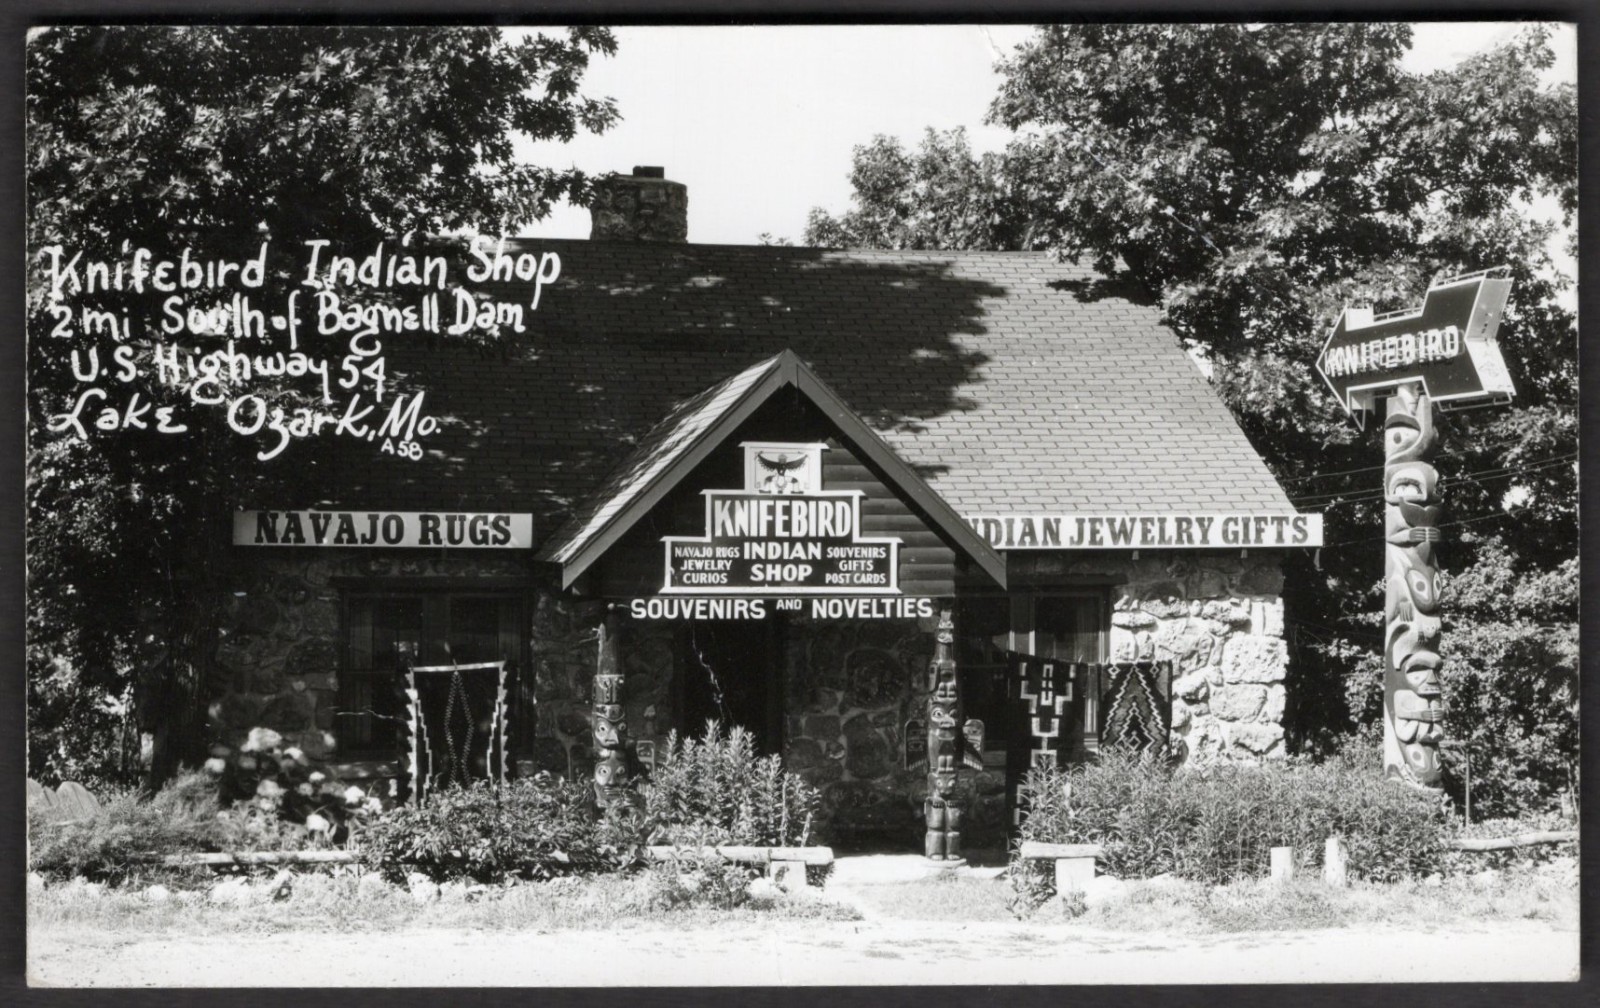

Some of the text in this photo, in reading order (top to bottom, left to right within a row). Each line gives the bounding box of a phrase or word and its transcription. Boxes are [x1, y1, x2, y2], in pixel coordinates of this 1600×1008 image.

[714, 499, 851, 538] KNIFEBIRD
[254, 512, 512, 547] NAVAJO RUGS
[1069, 515, 1215, 547] JEWELRY
[1221, 515, 1309, 545] GIFTS
[674, 545, 740, 559] NAVAJO RUGS
[743, 542, 822, 561] INDIAN
[826, 547, 887, 560] SOUVENIRS
[680, 560, 732, 572] JEWELRY
[750, 563, 813, 582] SHOP
[838, 560, 874, 572] GIFTS
[682, 572, 728, 584] CURIOS
[825, 573, 887, 584] POST CARDS
[630, 597, 933, 620] SOUVENIRS AND NOVELTIES
